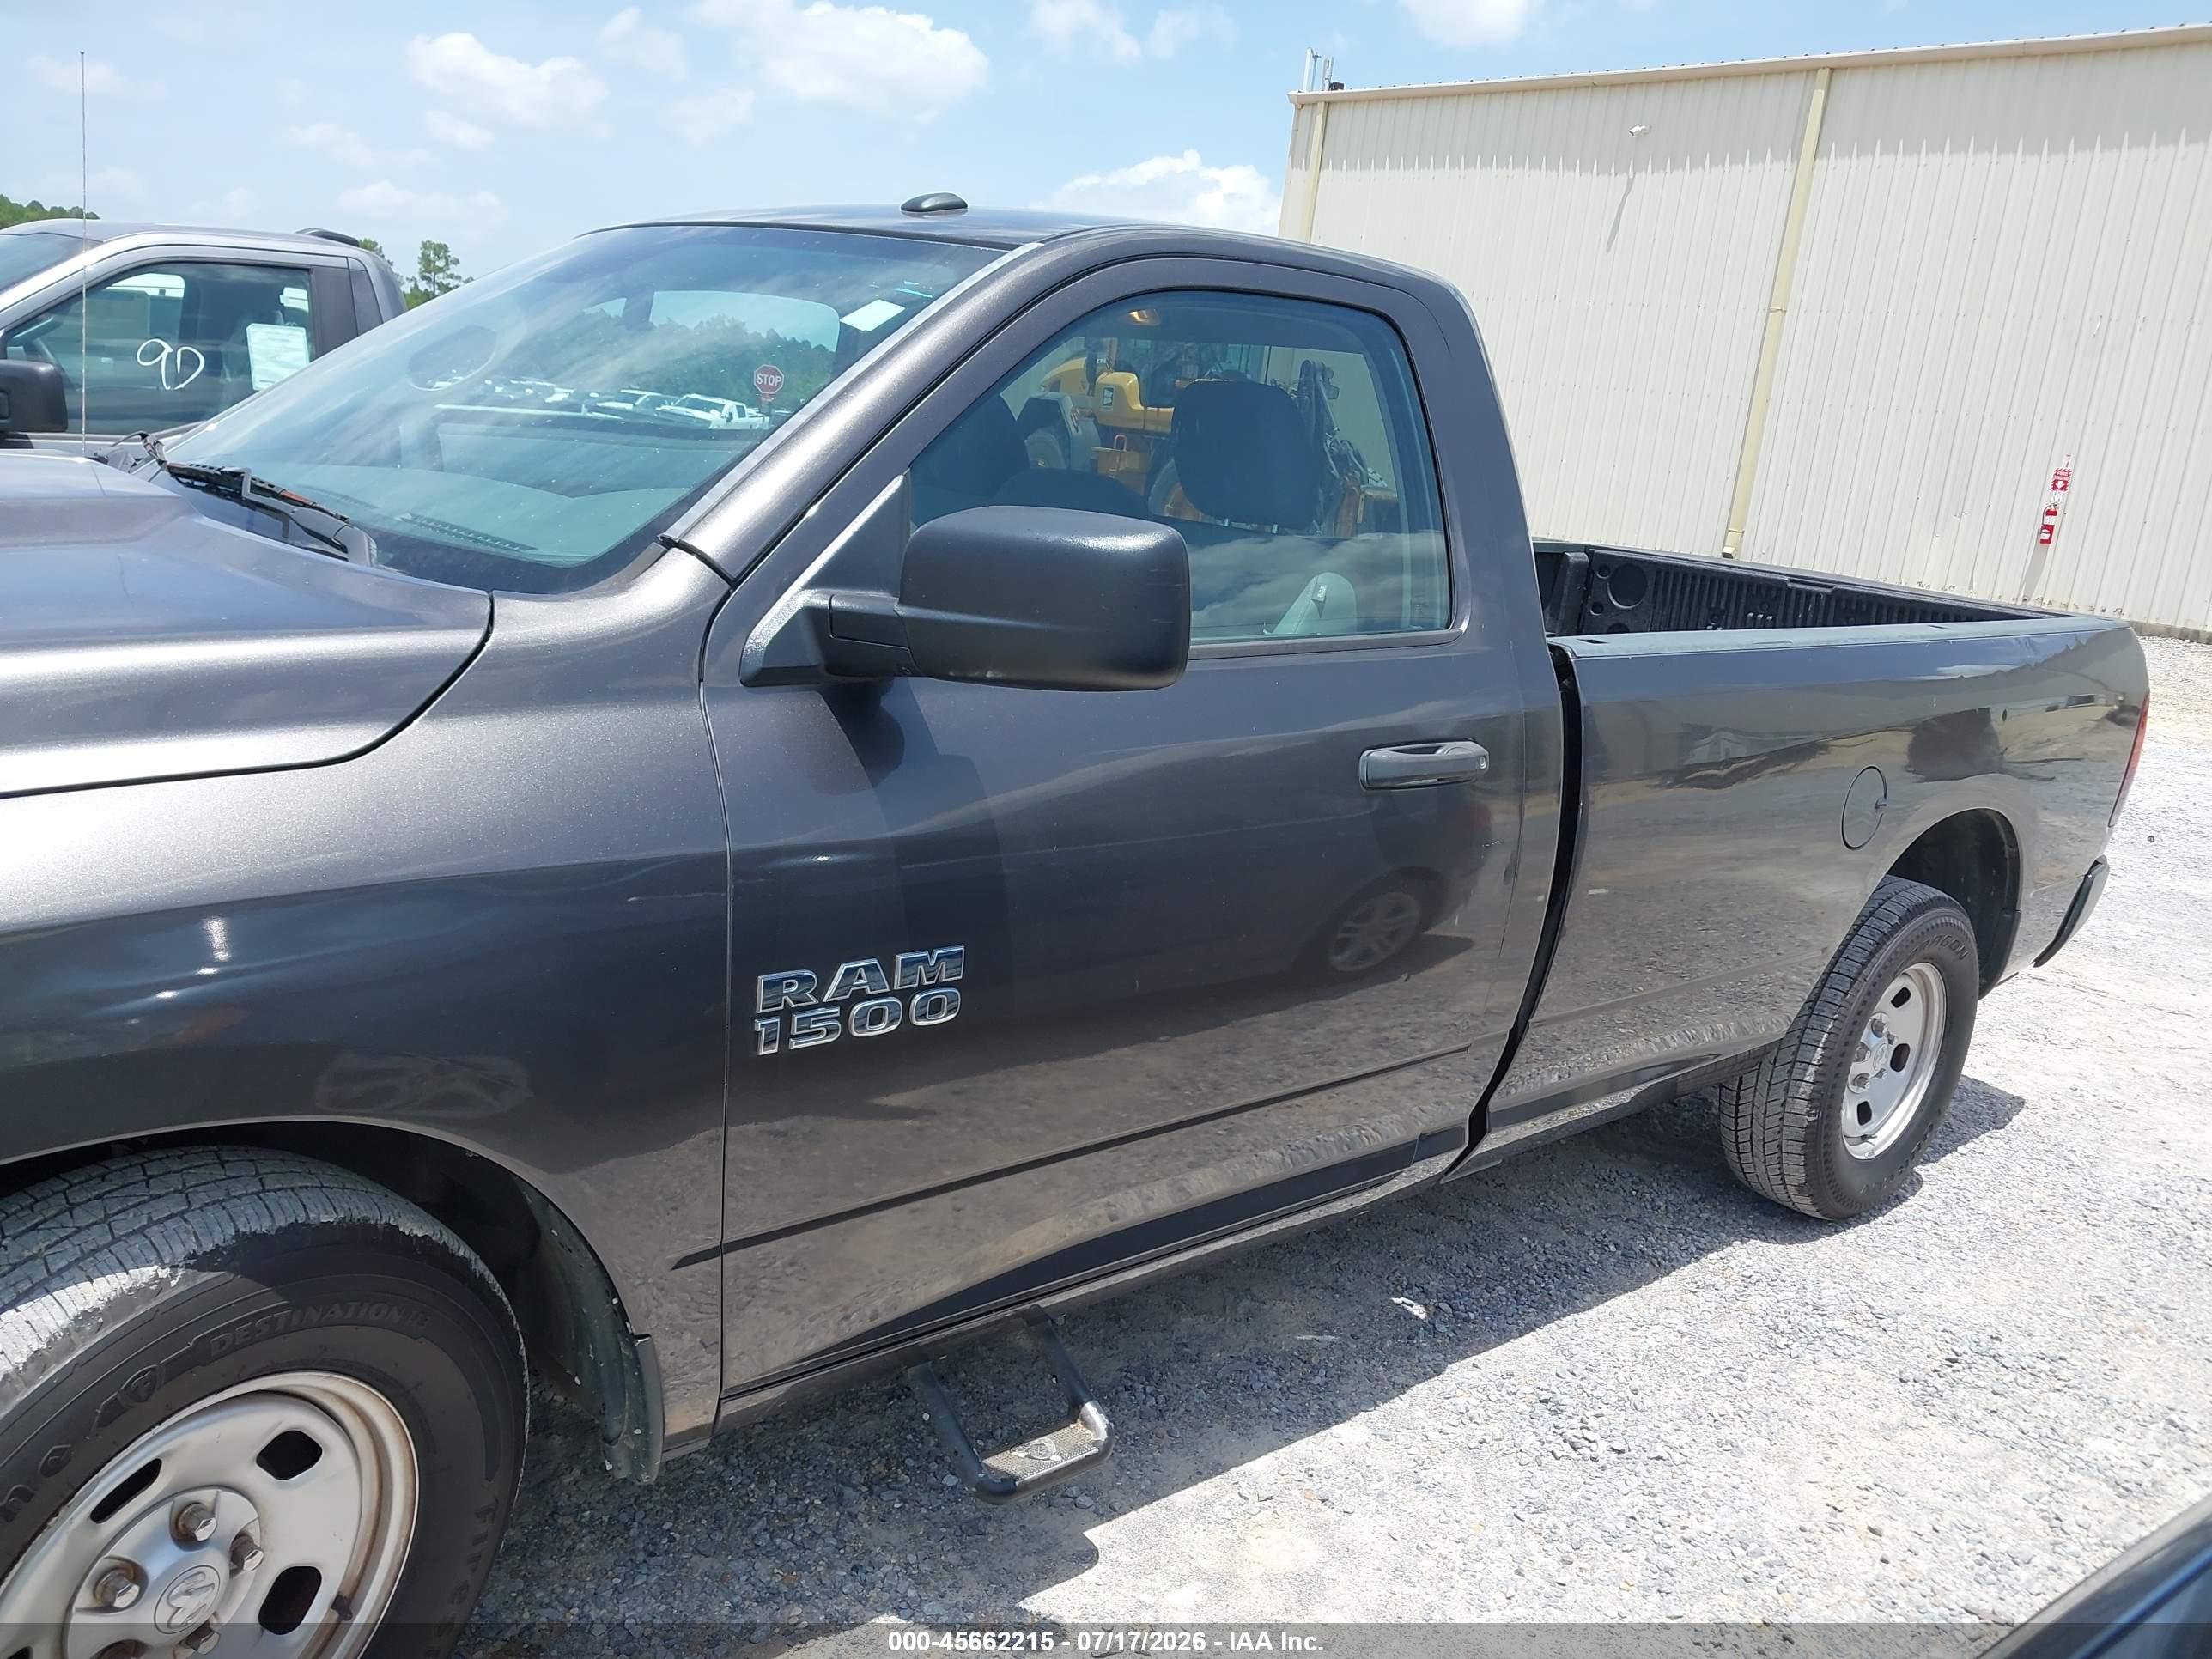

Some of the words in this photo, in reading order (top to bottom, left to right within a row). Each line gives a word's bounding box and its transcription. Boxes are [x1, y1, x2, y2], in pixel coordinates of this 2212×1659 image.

[757, 373, 782, 386] STOP
[756, 945, 965, 1014] RAM
[754, 987, 962, 1056] 1500
[209, 1300, 402, 1358] DESTINATION
